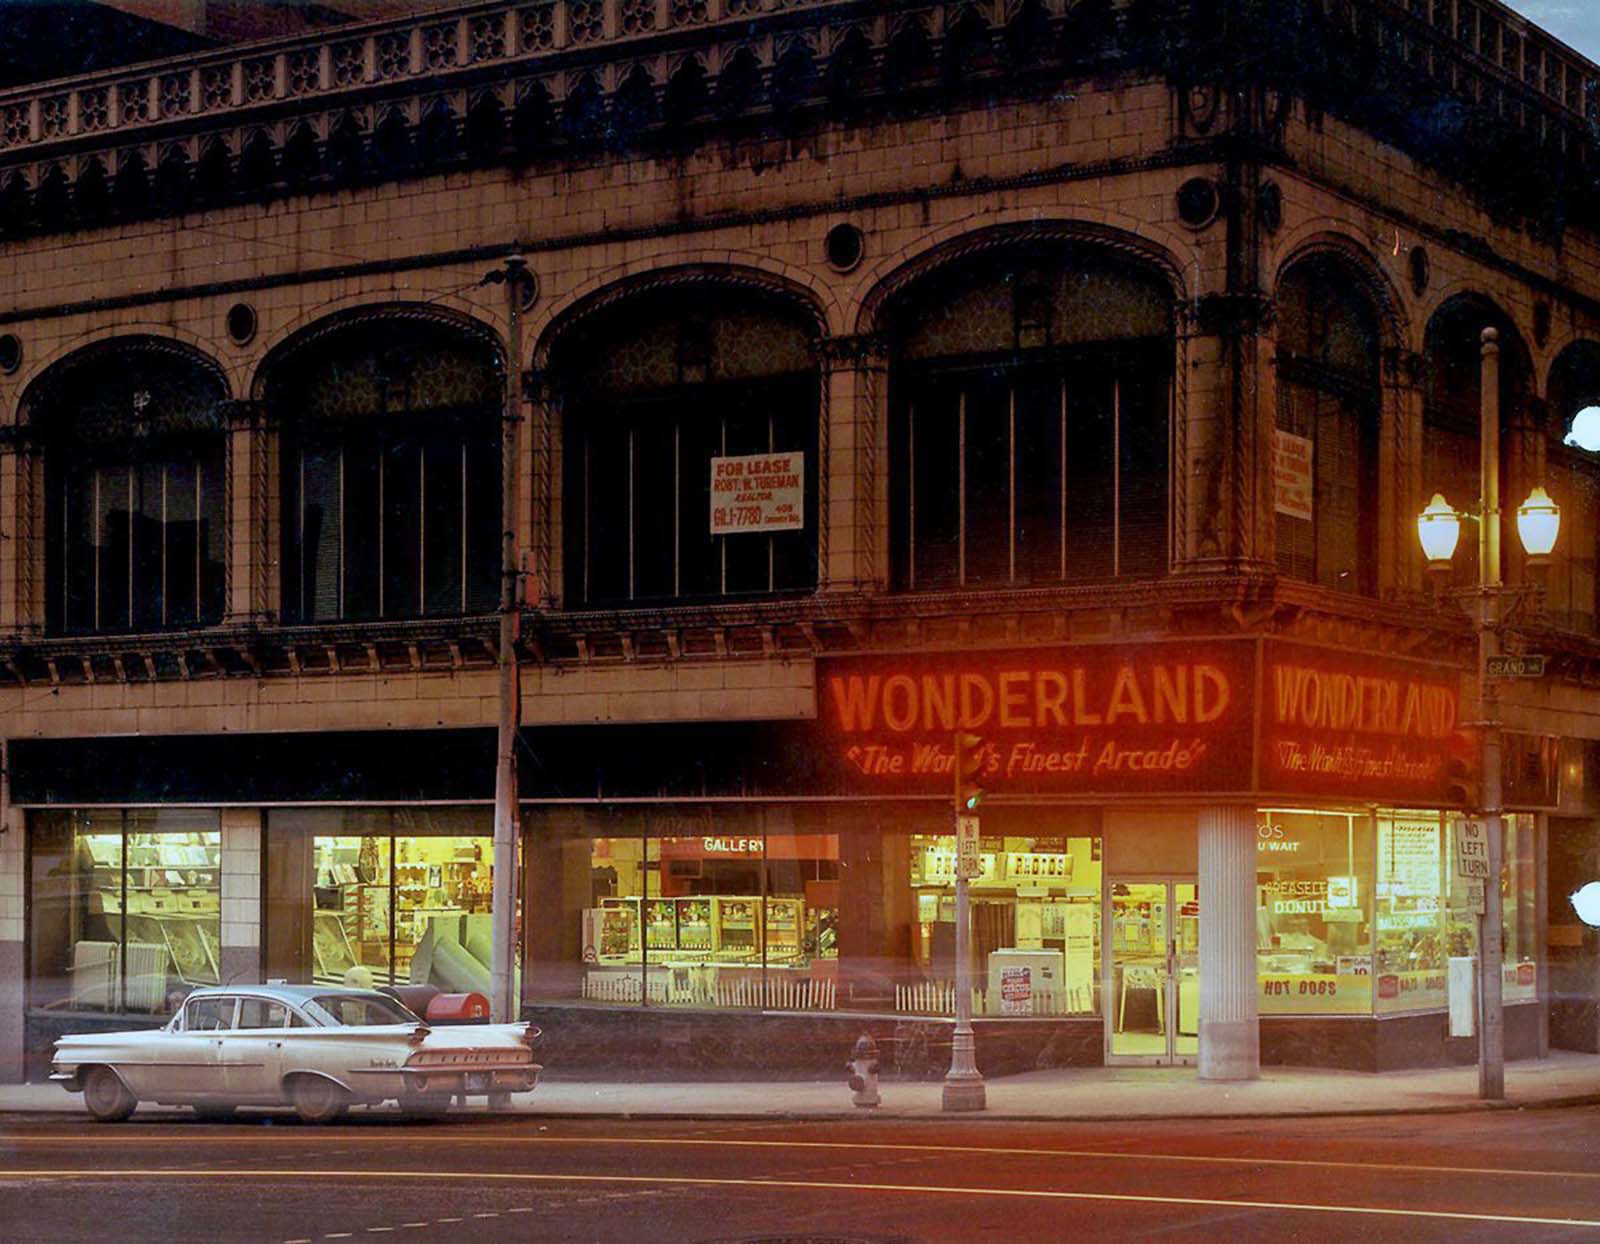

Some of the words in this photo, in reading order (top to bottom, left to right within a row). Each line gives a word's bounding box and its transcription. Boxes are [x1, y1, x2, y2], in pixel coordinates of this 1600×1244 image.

[716, 462, 744, 477] FOR
[747, 459, 791, 475] LEASE
[1488, 661, 1525, 674] GRAND
[831, 664, 1231, 732] WONDERLAND
[1273, 665, 1457, 737] WONDERLAND
[911, 741, 1000, 776] Wor's
[1007, 735, 1089, 776] Finest
[1257, 825, 1284, 838] OS
[1464, 823, 1479, 838] NO
[704, 838, 764, 852] GALLERY
[1269, 841, 1300, 852] WAIT
[1461, 841, 1484, 857] LEFT
[1015, 857, 1063, 875] PHOTOS
[1462, 859, 1488, 874] TURN
[1274, 900, 1338, 914] DONUTS
[1264, 980, 1290, 995] HOT
[1299, 980, 1336, 996] DOGS
